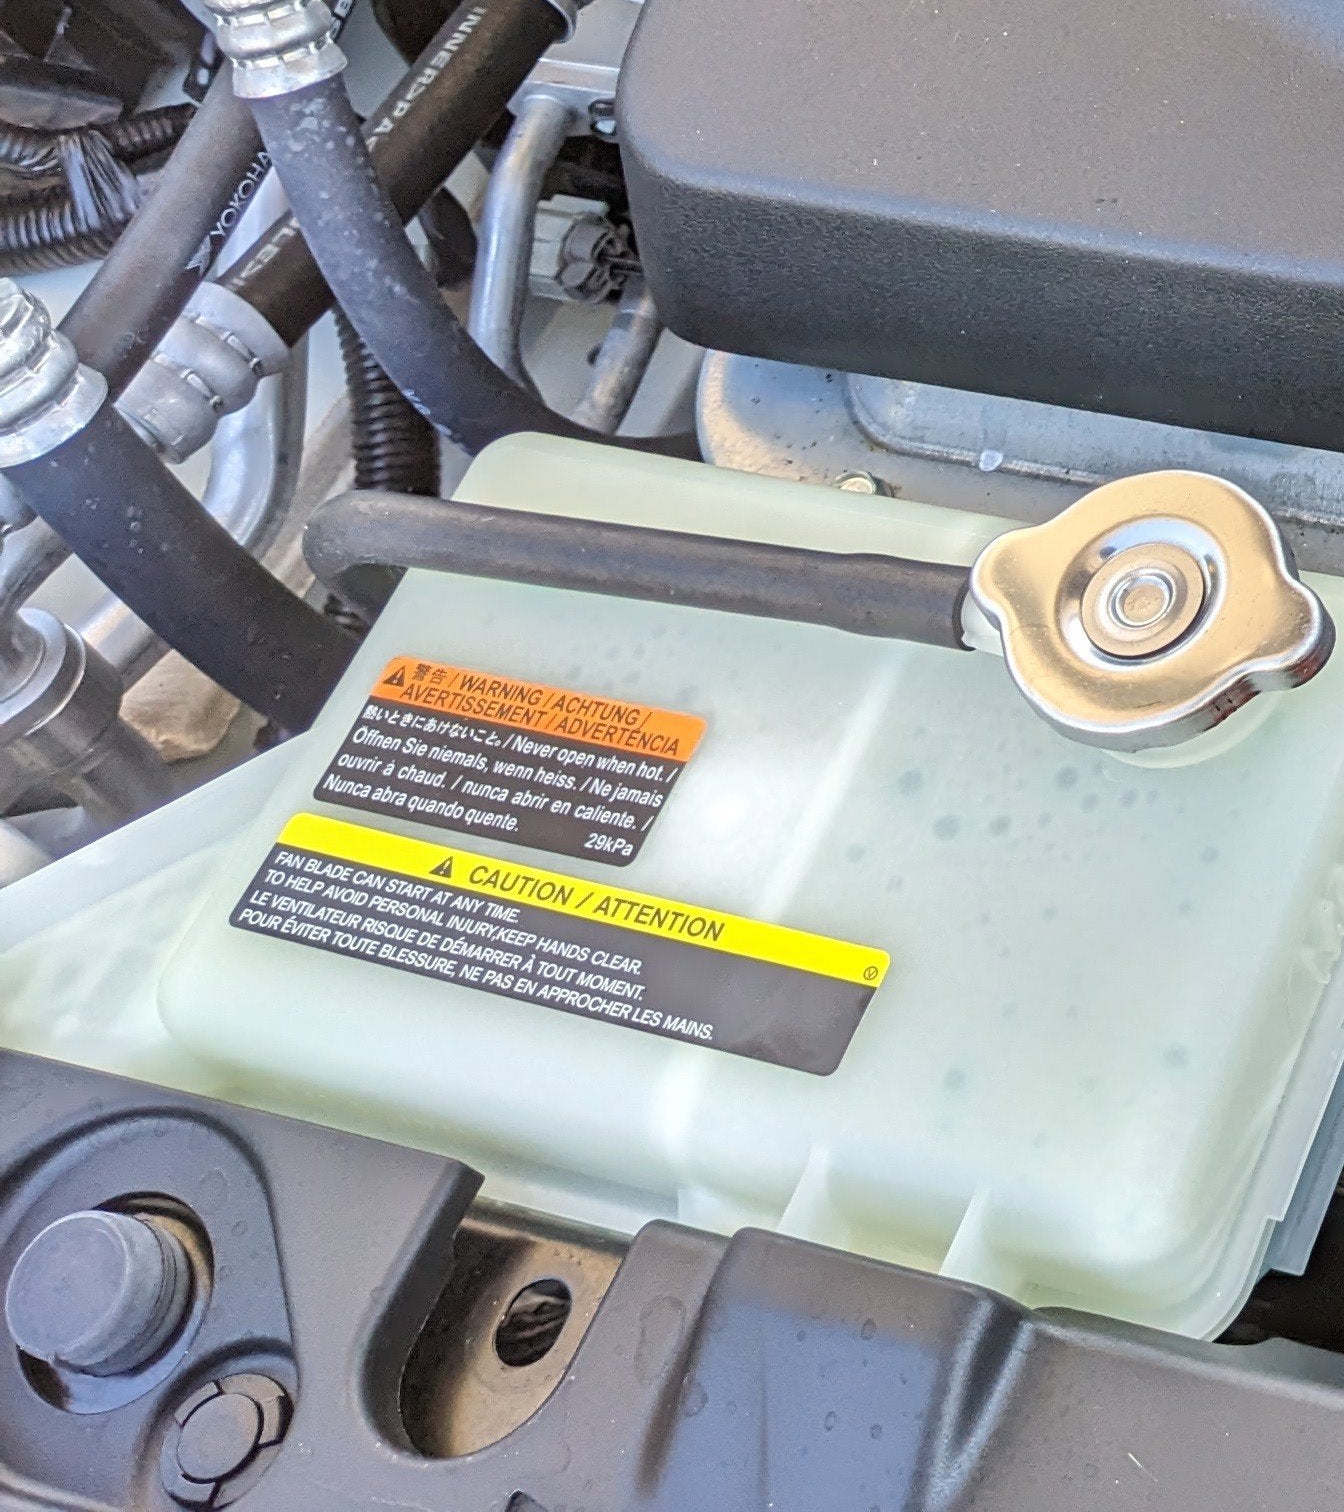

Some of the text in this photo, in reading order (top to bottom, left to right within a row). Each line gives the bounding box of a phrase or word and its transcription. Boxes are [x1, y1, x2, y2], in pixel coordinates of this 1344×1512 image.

[400, 683, 548, 728] AVERTISSEMENT
[411, 663, 449, 685] 警告
[459, 674, 544, 706] WARNING
[551, 694, 641, 726] ACHTUNG
[338, 753, 383, 772] ouvrir
[382, 759, 396, 777] à
[397, 764, 447, 789] chaud.
[461, 780, 509, 802] nunca
[511, 790, 550, 811] abrir
[550, 799, 572, 815] en
[574, 804, 637, 831] caliente.
[352, 726, 402, 751] Öffnen
[402, 737, 428, 757] Sie
[427, 745, 489, 773] niemals,
[492, 760, 535, 780] wenn
[534, 767, 577, 790] heiss.
[589, 778, 613, 797] Ne
[608, 783, 664, 808] jamais
[511, 735, 558, 759] Never
[557, 747, 596, 769] open
[597, 755, 640, 776] when
[636, 761, 664, 782] hot.
[322, 773, 519, 832] Nunca abra quando quente.
[584, 832, 635, 857] 29kPa
[264, 869, 287, 885] TO
[284, 874, 325, 894] HELP
[321, 885, 370, 906] AVOID
[367, 895, 445, 926] PERSONAL
[535, 936, 591, 962] HANDS
[590, 950, 643, 975] CLEAR.
[275, 851, 521, 923] FAN BLADE CAN START AT ANY TIME.
[469, 865, 575, 908] CAUTION
[592, 895, 726, 942] ATTENTION
[237, 907, 714, 1041] POUR ÉVITER TOUTE BLESSURE, NE PAS EN APPROCHER LES MAINS.
[250, 889, 647, 1001] LE VENTILATEUR RISQUE DE DÉMARRER À TOUT MOMENT.
